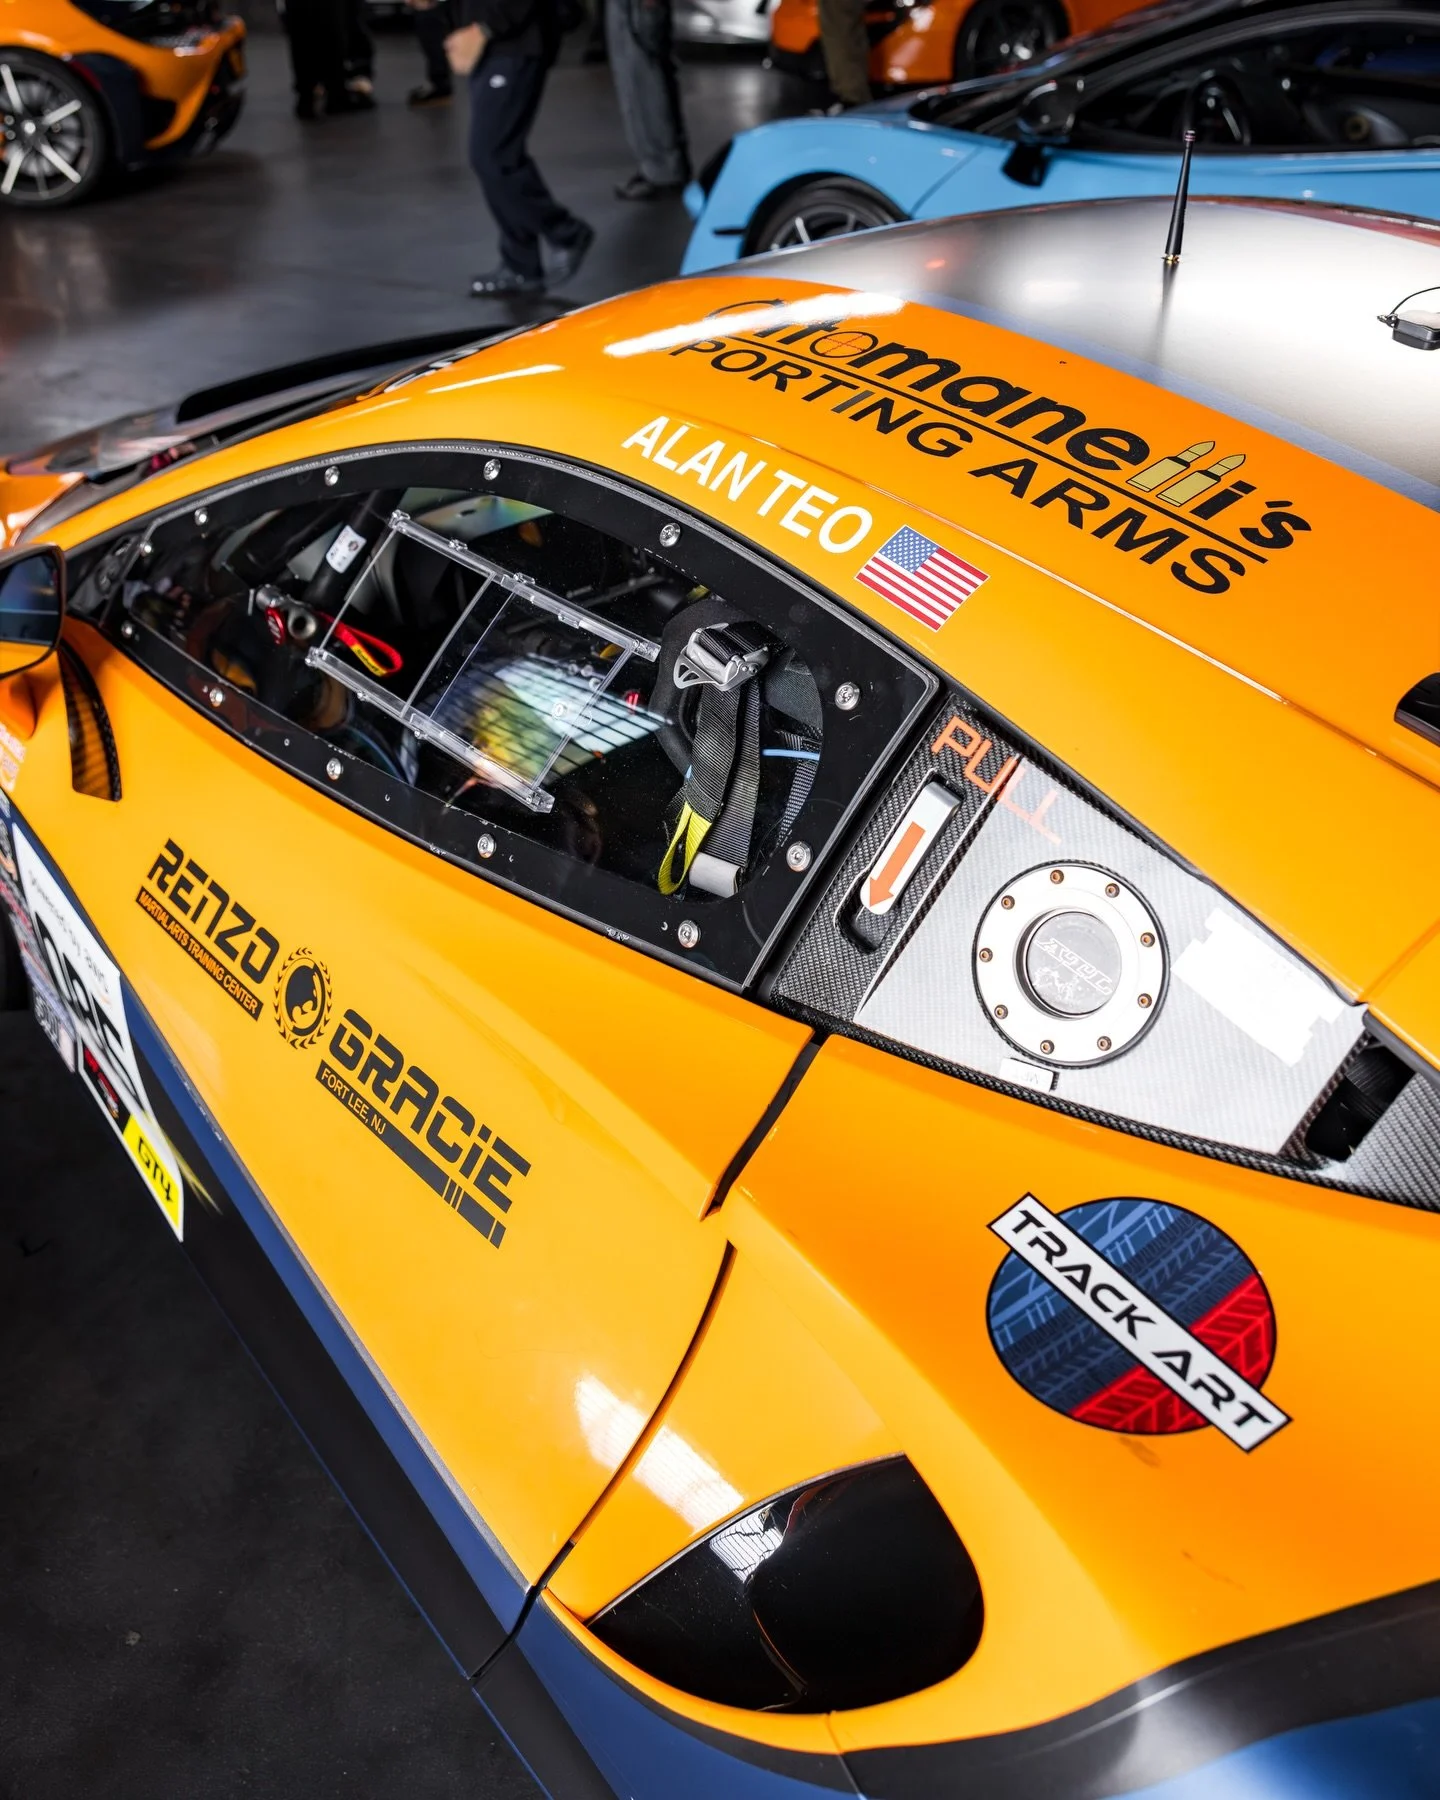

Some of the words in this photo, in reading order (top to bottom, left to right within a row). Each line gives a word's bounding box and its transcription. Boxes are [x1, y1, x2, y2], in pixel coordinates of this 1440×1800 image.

[620, 415, 768, 502] ALAN
[756, 469, 873, 554] TEO
[654, 335, 974, 459] PORTING
[967, 458, 1247, 595] ARMS
[931, 715, 1062, 844] PULL
[139, 890, 169, 928] MARTIAL
[167, 920, 190, 947] ARTS
[187, 938, 225, 981] TRAINING
[223, 975, 258, 1014] CENTER
[147, 838, 280, 985] RENZO
[138, 1136, 173, 1203] GT4
[321, 1068, 350, 1099] FORT
[347, 1092, 370, 1124] LEE,
[370, 1114, 386, 1135] NJ
[329, 1008, 532, 1214] GRACIE
[1012, 1209, 1157, 1341] TRACK
[1151, 1349, 1273, 1428] ART
